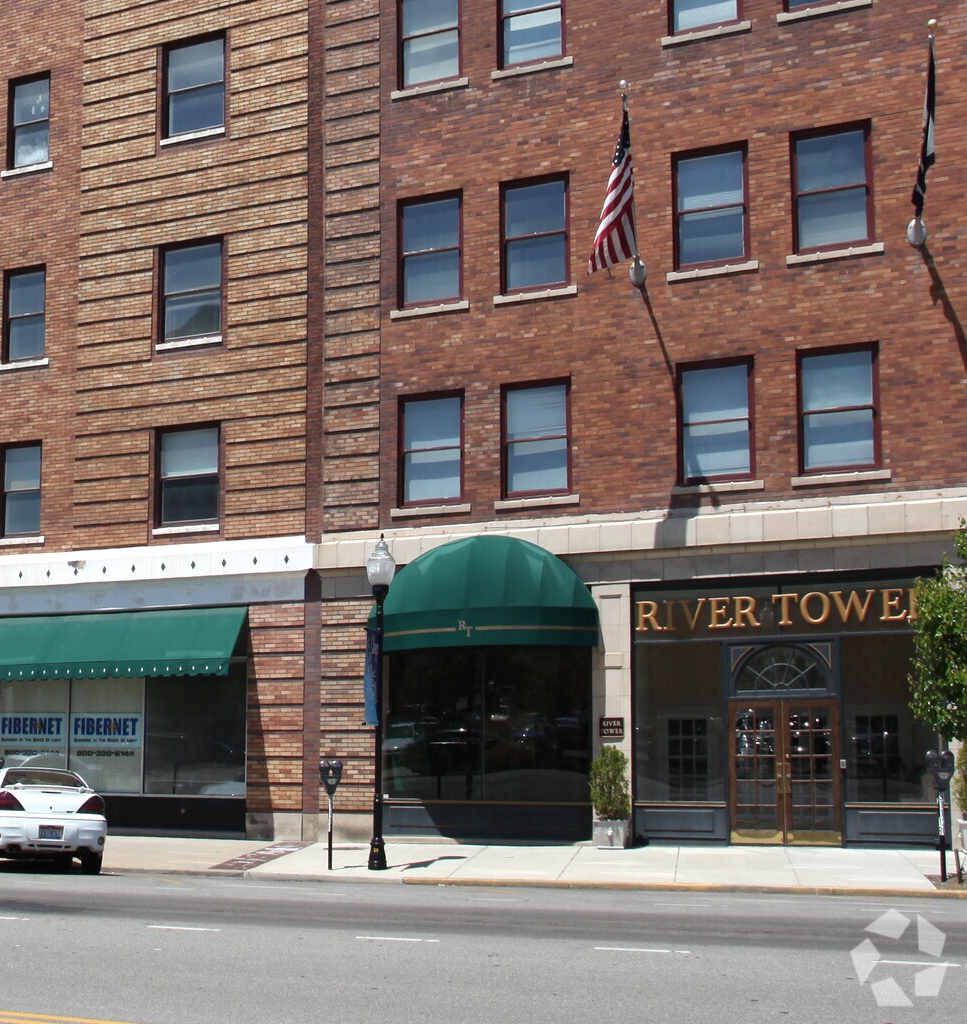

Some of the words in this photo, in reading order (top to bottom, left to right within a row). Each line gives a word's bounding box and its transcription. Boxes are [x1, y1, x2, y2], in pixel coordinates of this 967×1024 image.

[635, 596, 761, 631] RIVER
[1, 717, 63, 735] FIBERNET
[74, 717, 138, 736] FIBERNET
